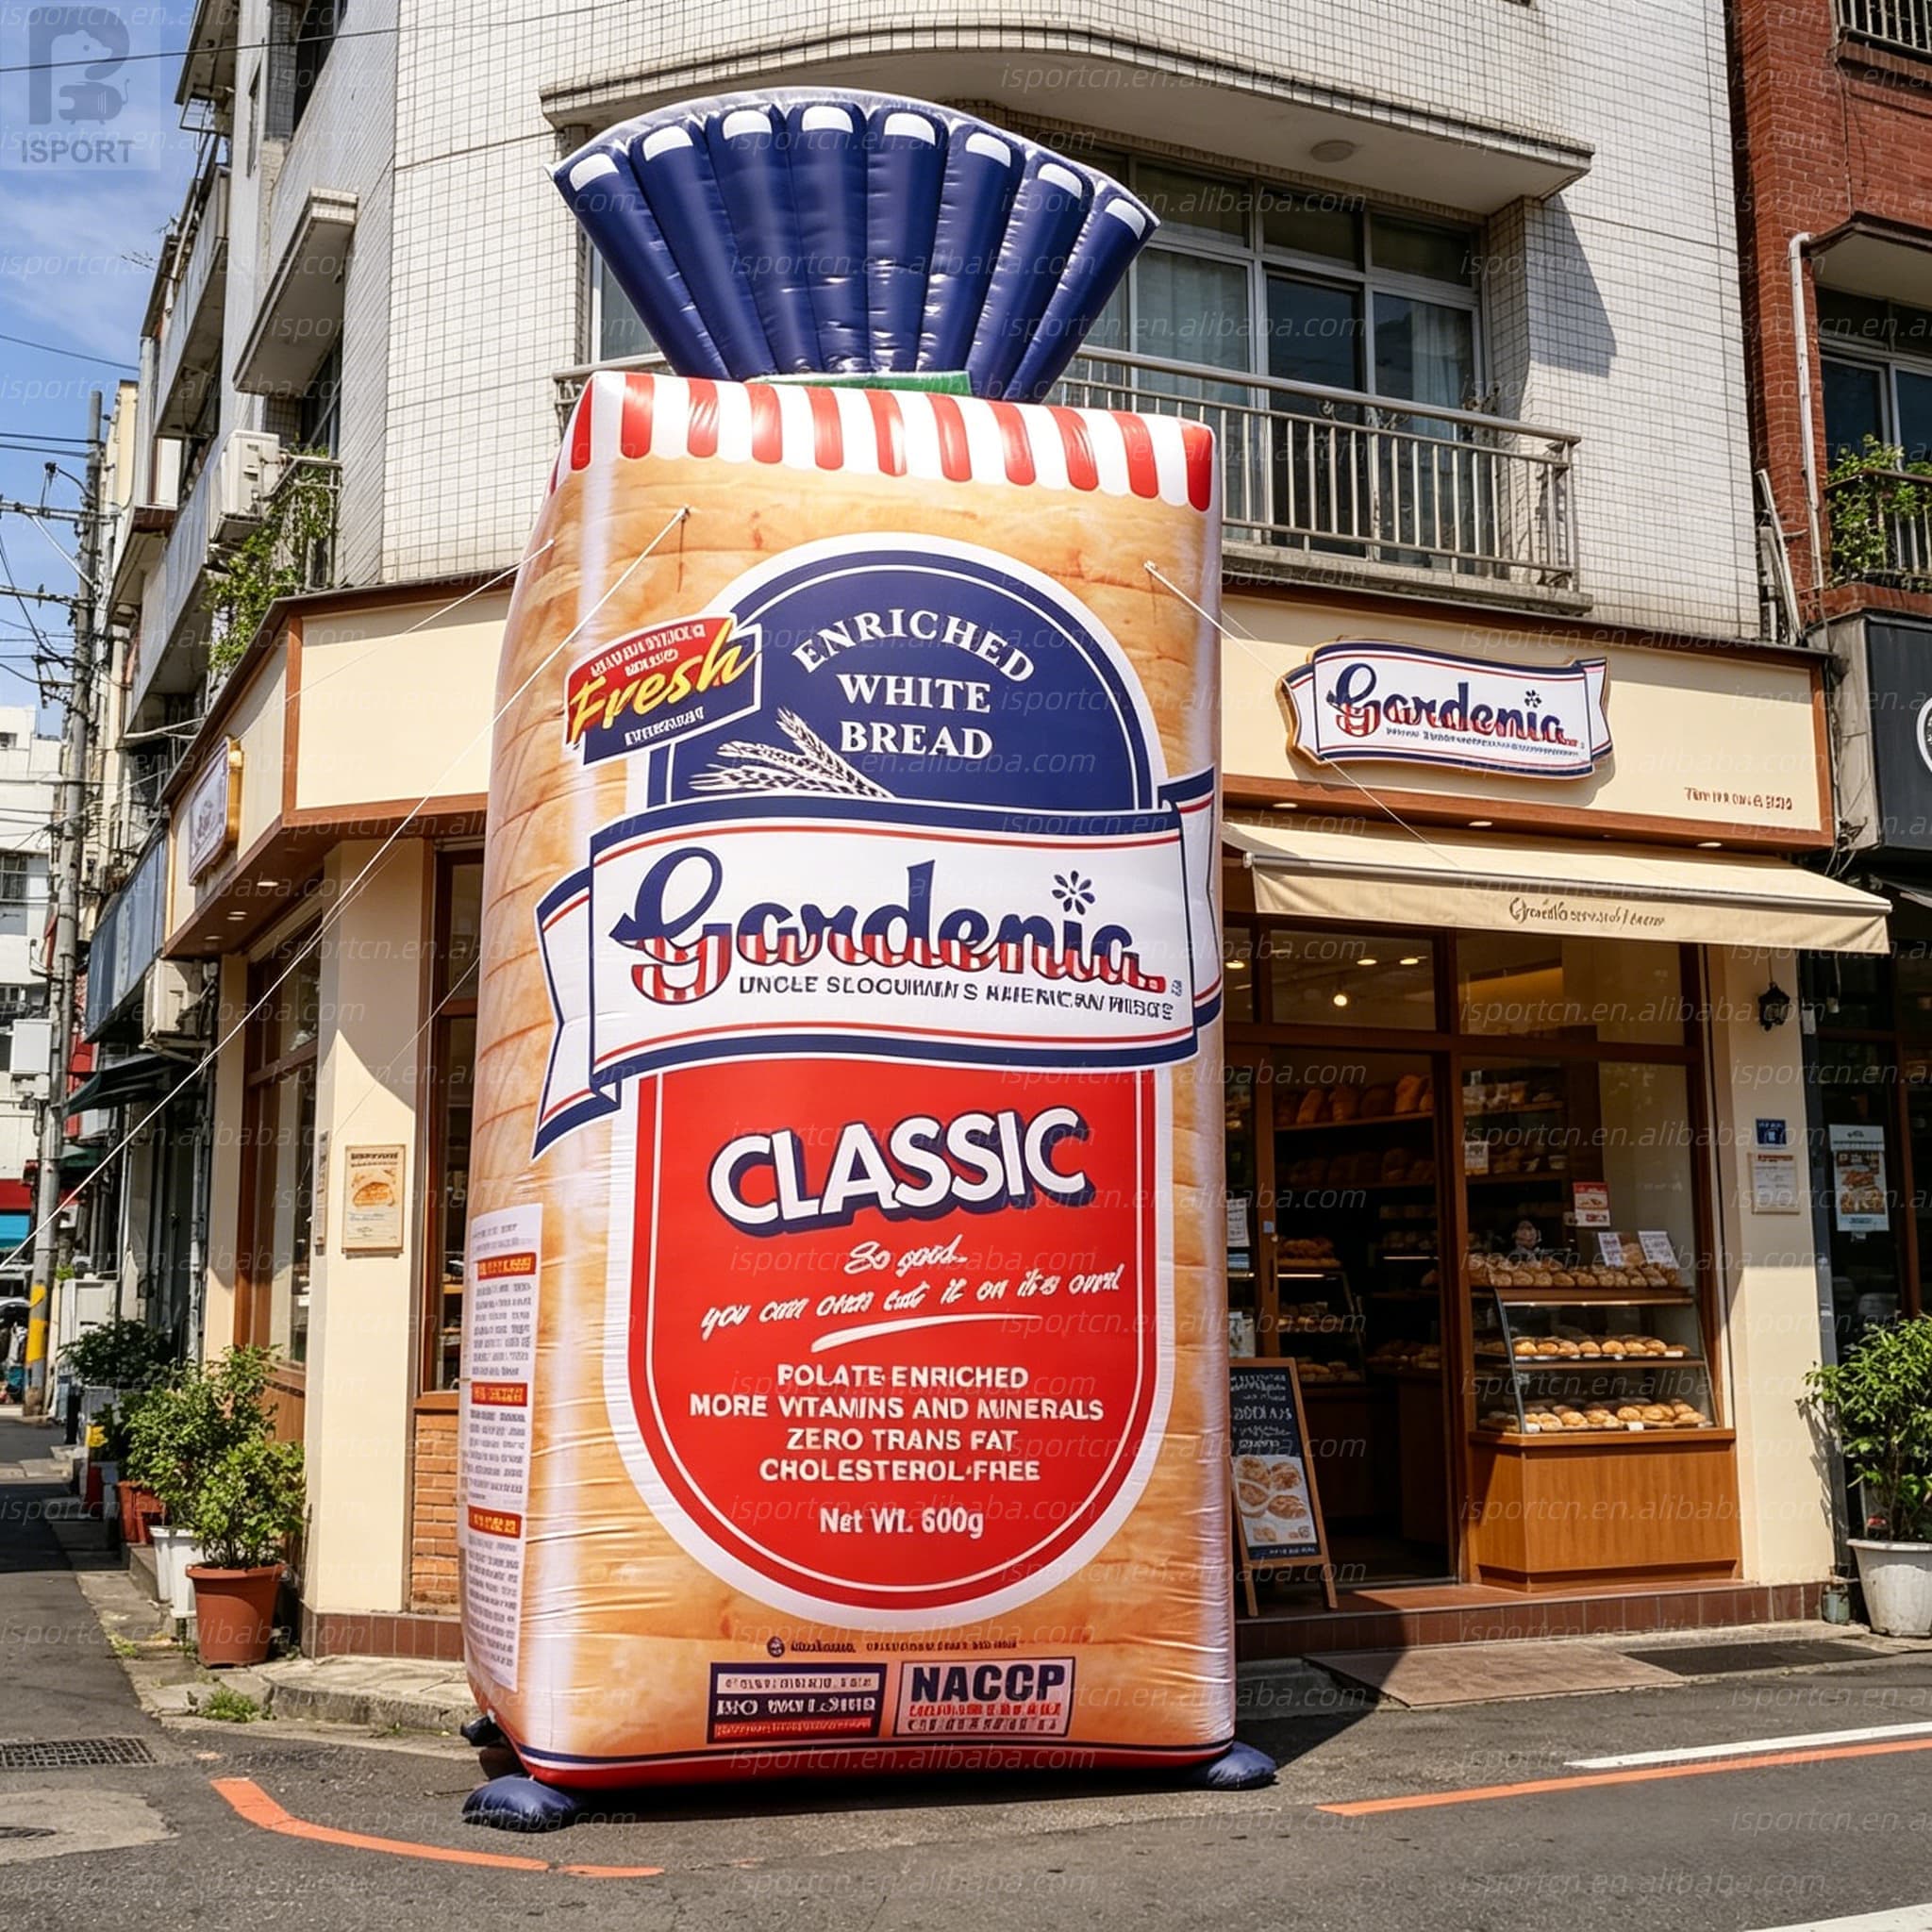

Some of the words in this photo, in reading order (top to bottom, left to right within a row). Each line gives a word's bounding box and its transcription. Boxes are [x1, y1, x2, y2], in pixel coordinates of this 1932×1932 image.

[791, 608, 1035, 682] ENRICHED
[570, 618, 757, 743] Fresh
[836, 674, 991, 714] WHITE
[1326, 662, 1577, 745] Gardenia
[839, 720, 993, 760] BREAD
[608, 846, 1166, 1007] Gardenia
[708, 1106, 1092, 1234] CLASSIC
[843, 1241, 891, 1274] So
[690, 1393, 768, 1418] MORE
[911, 1397, 970, 1421] AND
[786, 1427, 864, 1451] ZERO
[871, 1428, 961, 1452] TRANS
[970, 1429, 1019, 1452] FAT
[819, 1507, 863, 1534] Net
[921, 1507, 984, 1540] 600g
[910, 1663, 1065, 1703] NACCP
